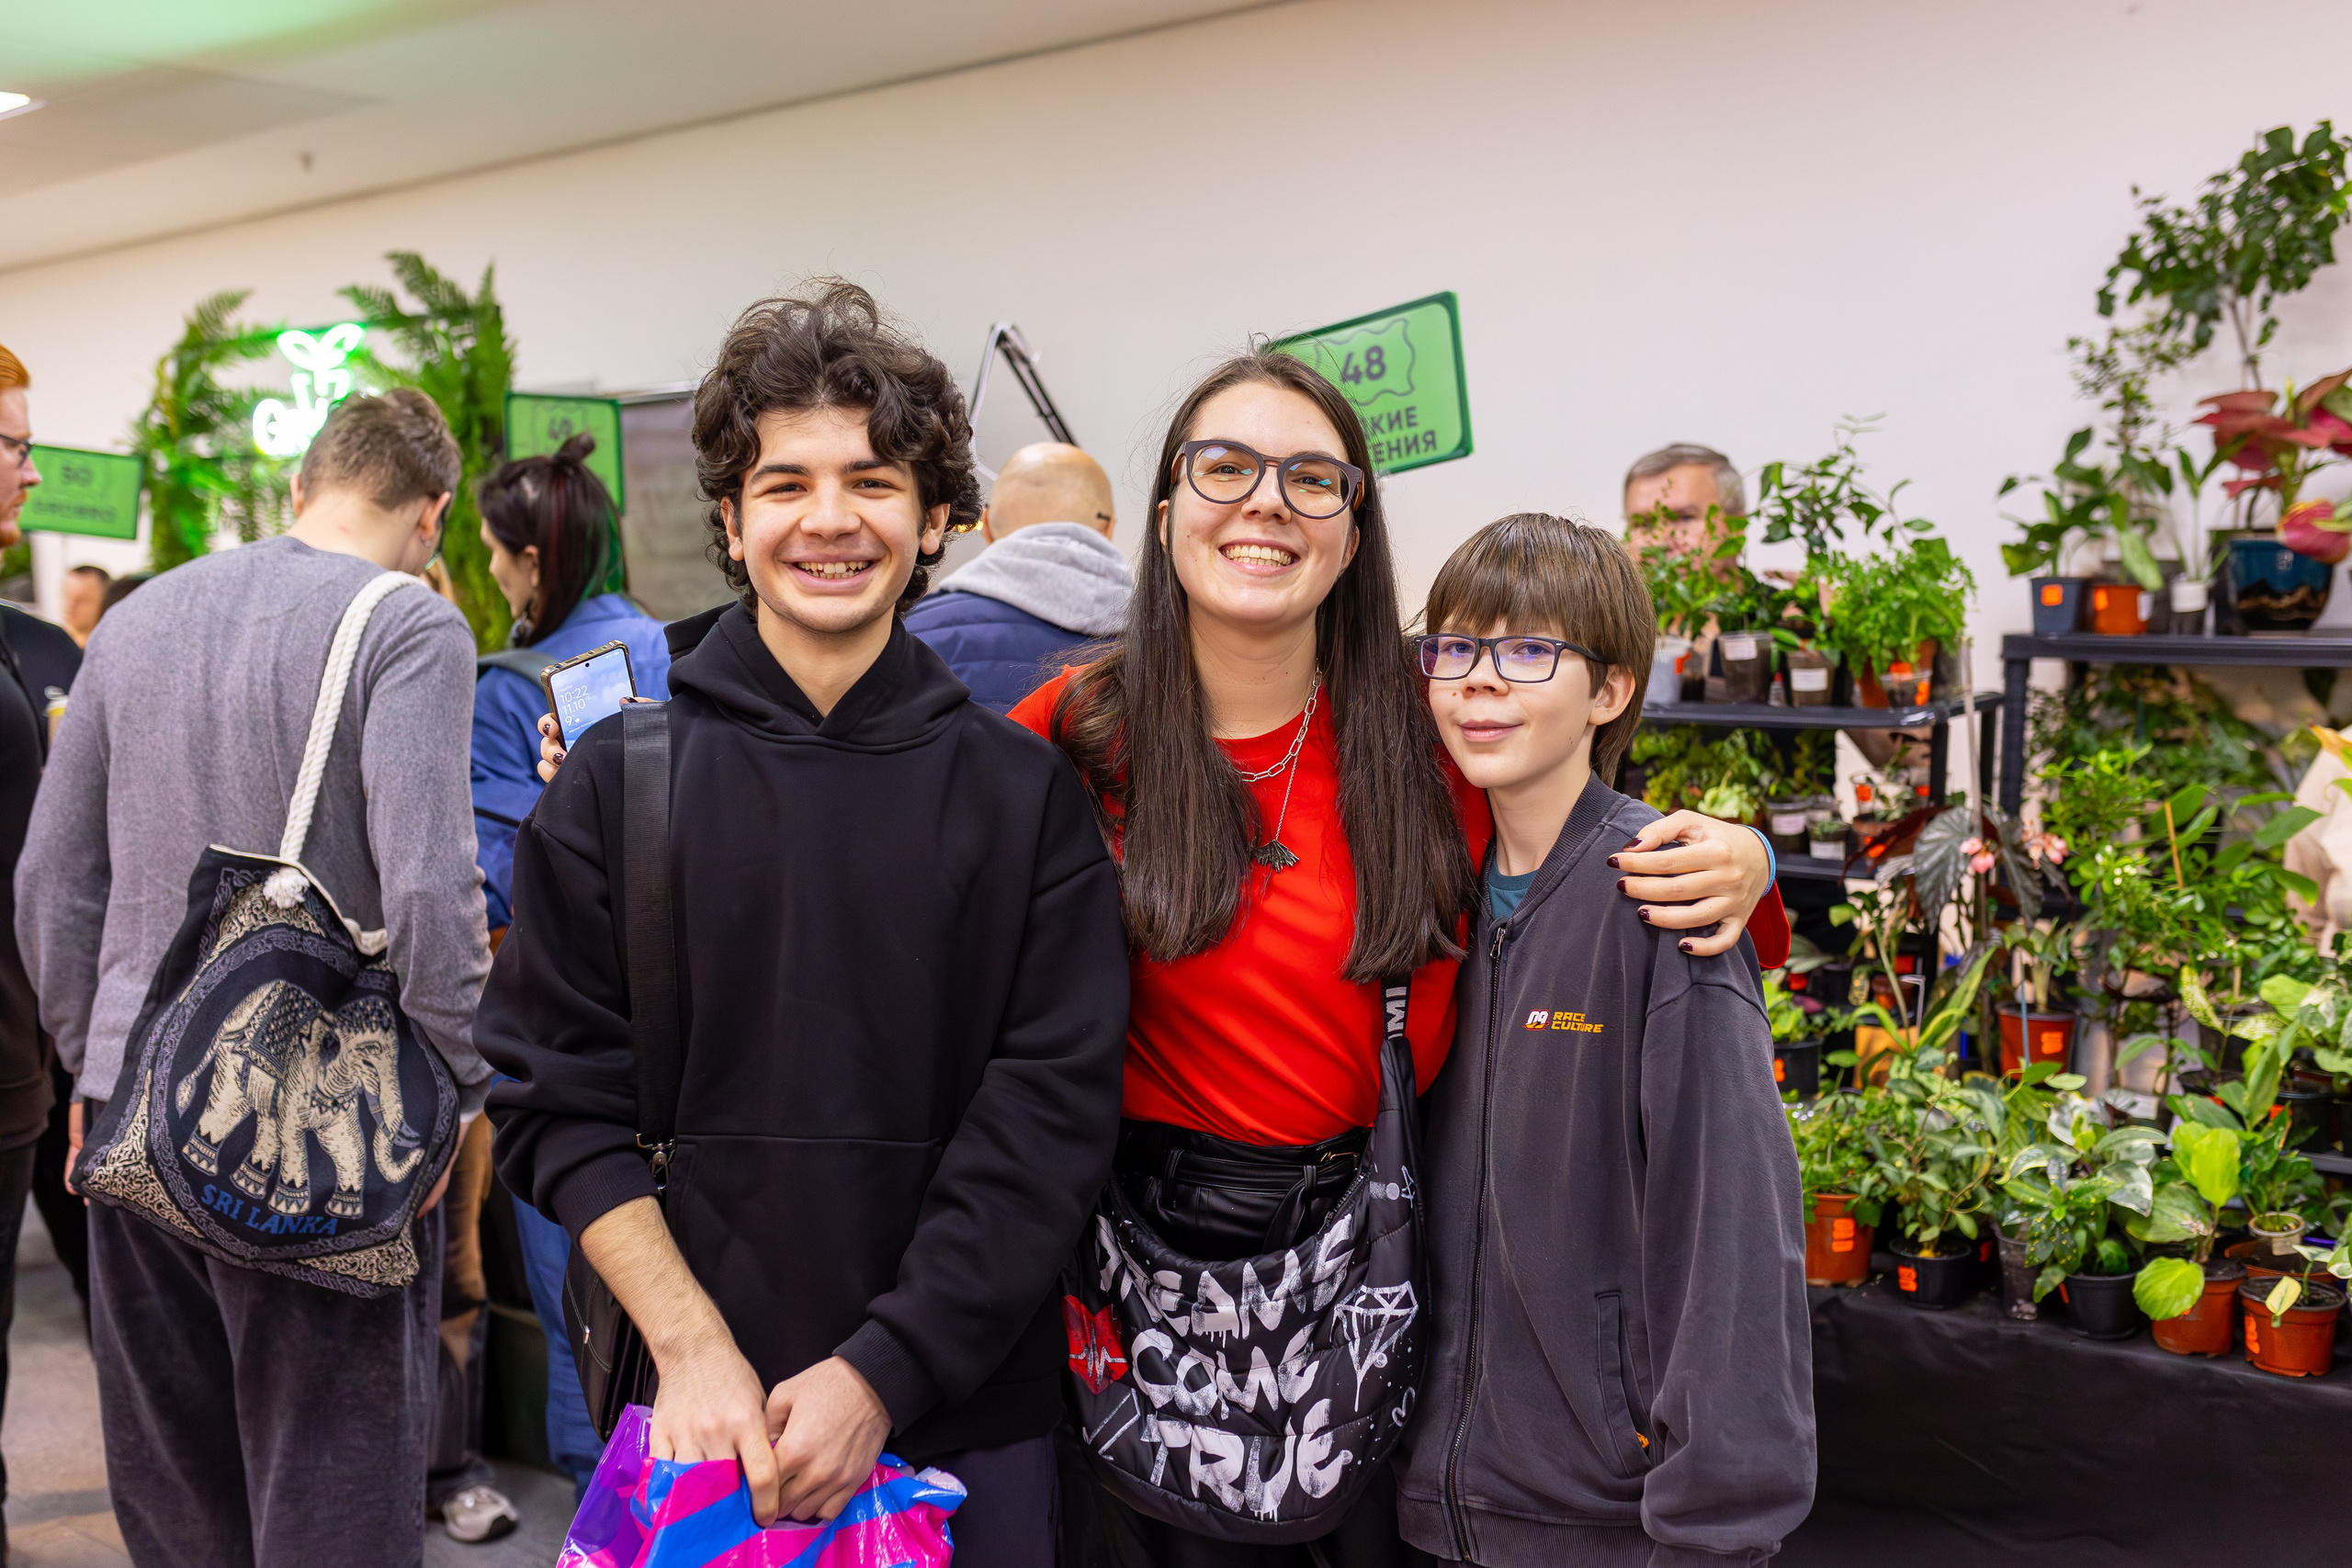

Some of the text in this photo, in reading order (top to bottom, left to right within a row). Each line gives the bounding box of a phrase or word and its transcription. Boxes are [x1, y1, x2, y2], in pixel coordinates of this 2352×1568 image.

[1341, 344, 1386, 384] 48
[1368, 406, 1419, 434] КИЕ
[1371, 429, 1437, 463] ЕНИЯ
[560, 685, 589, 705] 10:22
[562, 698, 586, 716] 11.10
[1553, 1011, 1586, 1022] RACE
[200, 1183, 339, 1236] SRI LANKA
[1131, 1322, 1320, 1420] COME
[1140, 1398, 1352, 1522] TRUE
